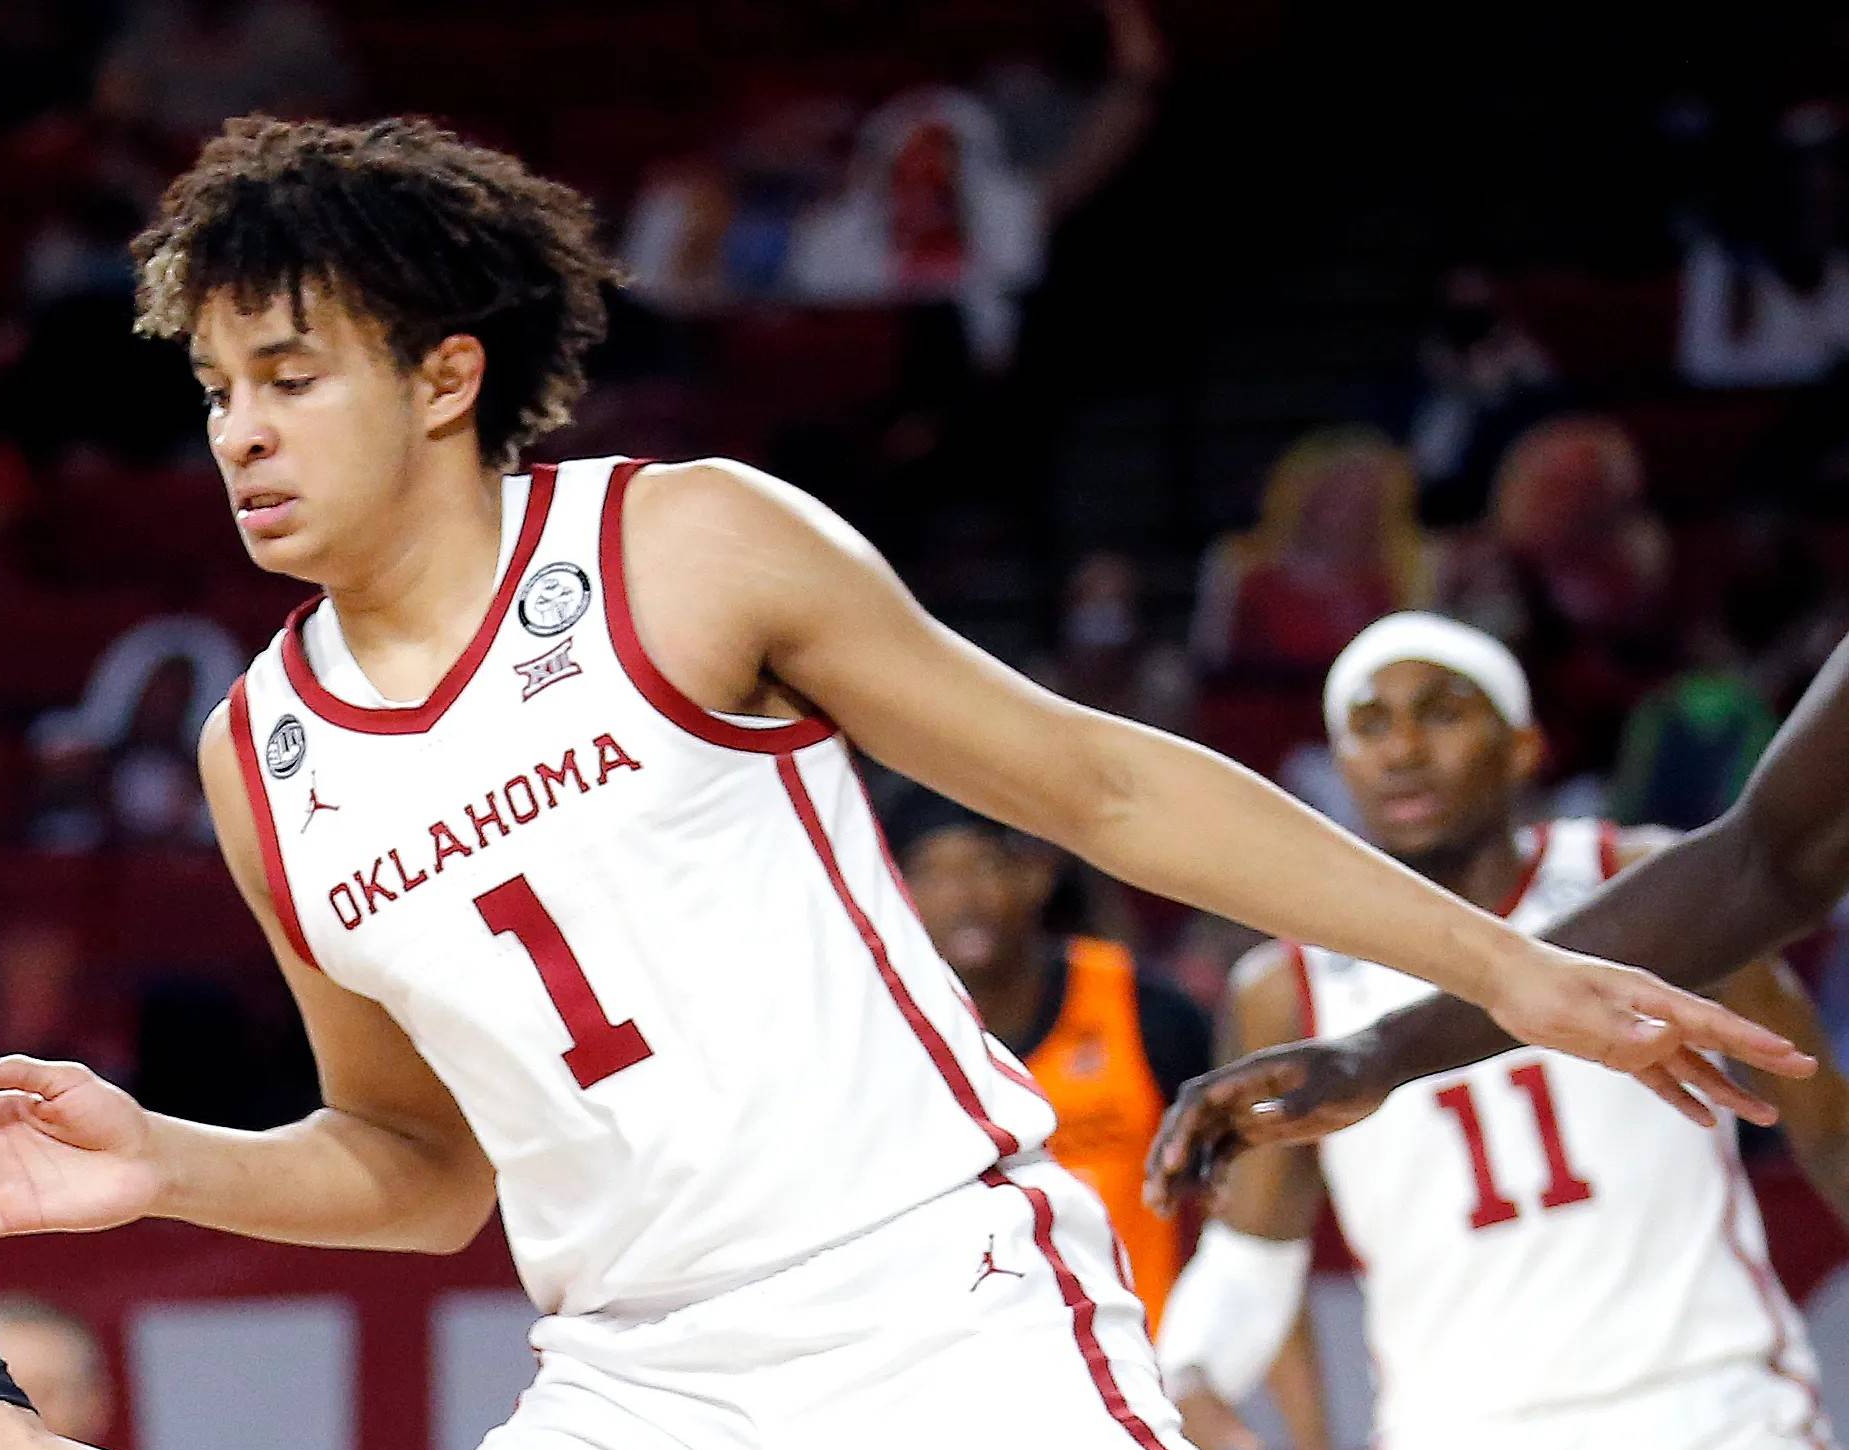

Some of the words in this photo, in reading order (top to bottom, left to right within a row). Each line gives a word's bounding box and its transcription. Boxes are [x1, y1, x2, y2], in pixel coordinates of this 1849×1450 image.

[328, 733, 641, 930] OKLAHOMA
[473, 873, 654, 1090] 1
[1437, 1063, 1594, 1230] 11
